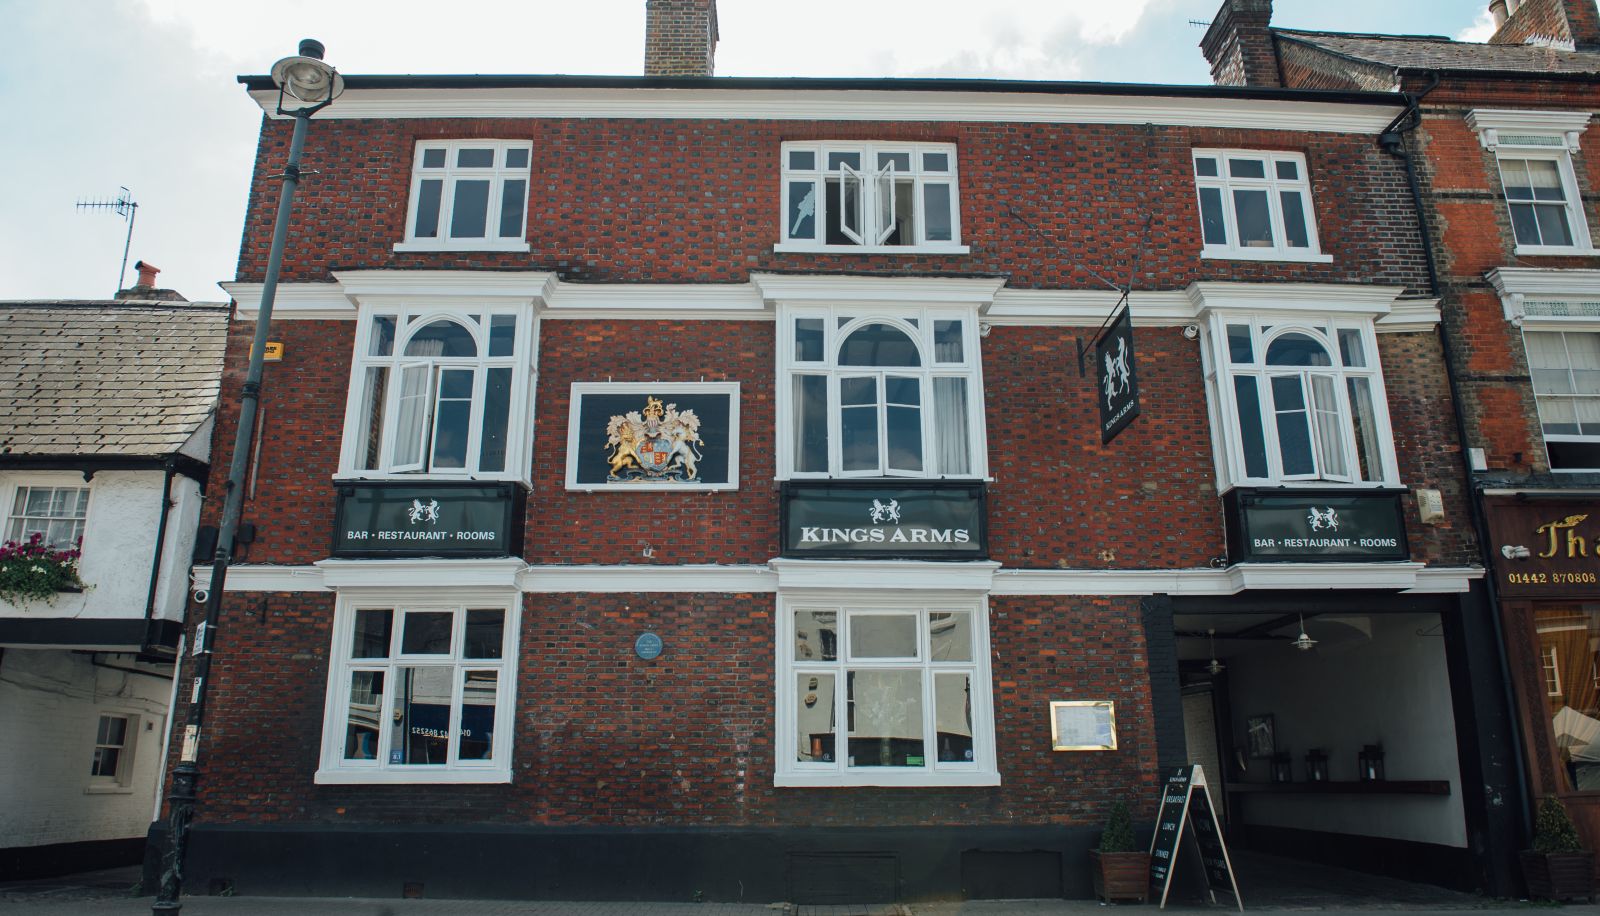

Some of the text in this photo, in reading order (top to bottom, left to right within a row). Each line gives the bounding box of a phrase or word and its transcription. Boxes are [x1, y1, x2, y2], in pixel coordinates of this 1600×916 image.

[1120, 400, 1134, 417] ARMS
[347, 531, 495, 540] BAR RESTAURANT ROOMS
[800, 527, 970, 543] KINGS ARMS
[1536, 514, 1600, 558] Th
[1254, 538, 1397, 547] BAR RESTAURANT ROOMS
[1508, 572, 1596, 584] 01442 870808
[1162, 822, 1176, 831] LUNCH
[1155, 849, 1170, 859] DINNER
